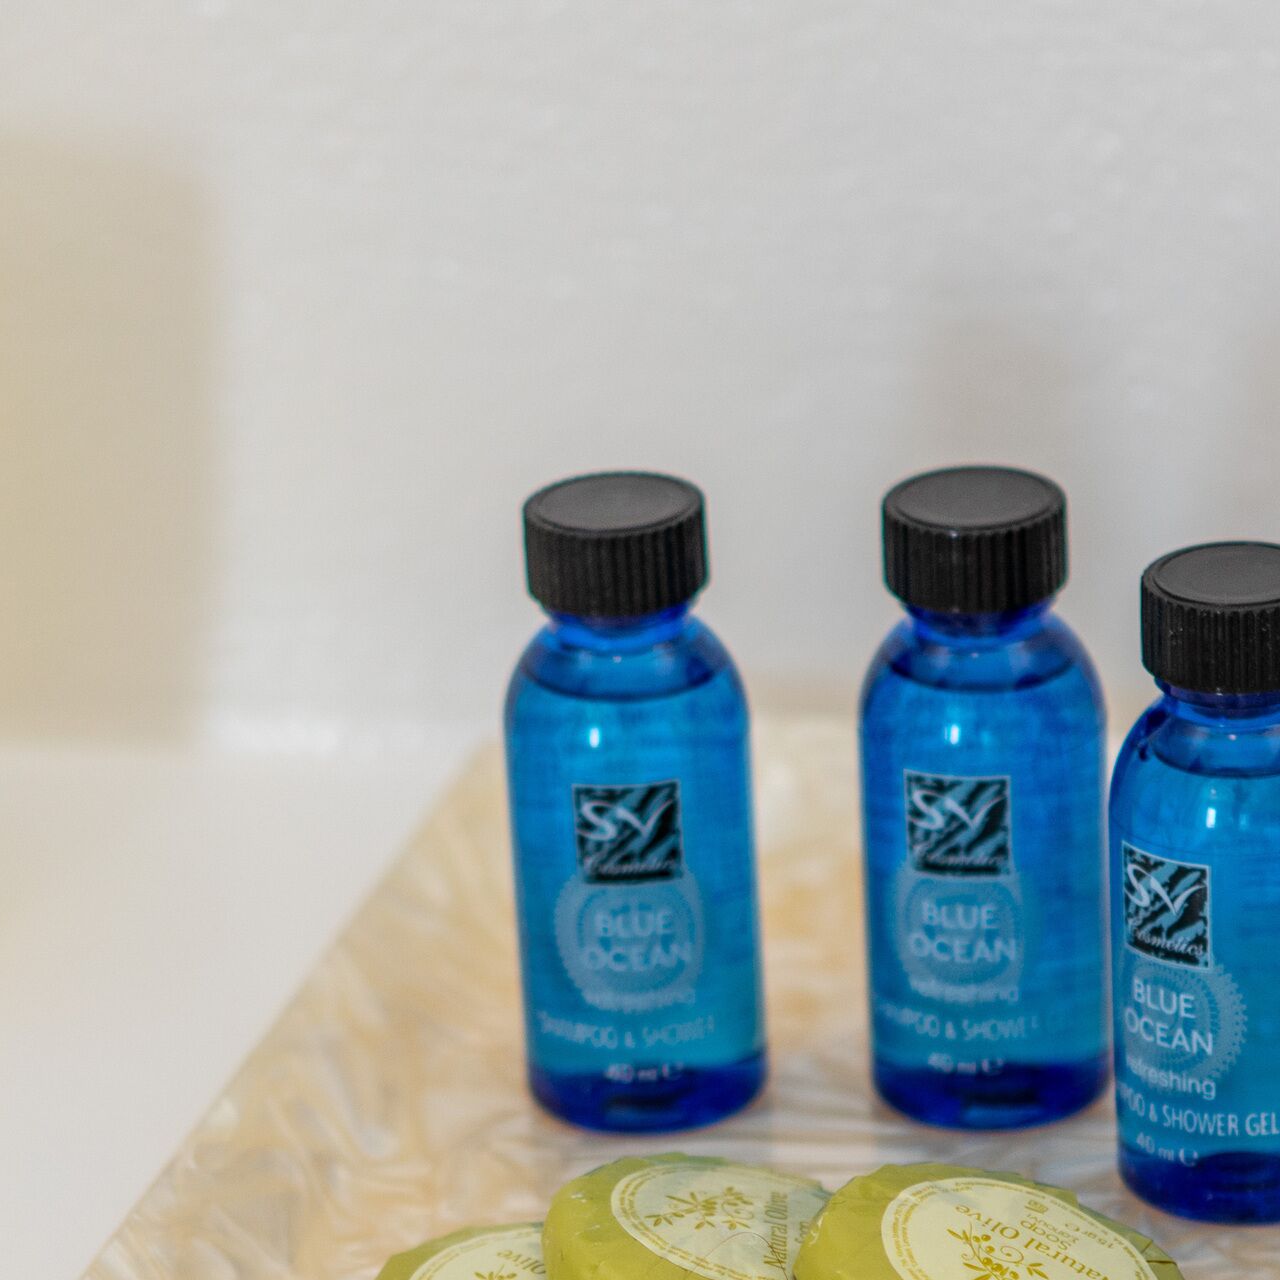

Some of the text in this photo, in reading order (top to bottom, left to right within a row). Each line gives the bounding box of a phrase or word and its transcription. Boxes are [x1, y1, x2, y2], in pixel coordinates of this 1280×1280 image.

[594, 909, 673, 938] BLUE
[921, 901, 999, 929] BLUE
[583, 943, 692, 972] OCEAN
[910, 932, 1016, 963] OCEAN
[1132, 977, 1196, 1019] BLUE
[1124, 1007, 1213, 1056] OCEAN
[1162, 1102, 1239, 1137] SHOWER
[1245, 1111, 1280, 1137] GEL
[1136, 1130, 1156, 1154] 40
[955, 1204, 1020, 1240] Olive
[1020, 1219, 1071, 1250] Soap
[763, 1220, 787, 1271] Natural
[497, 1250, 547, 1275] Olive
